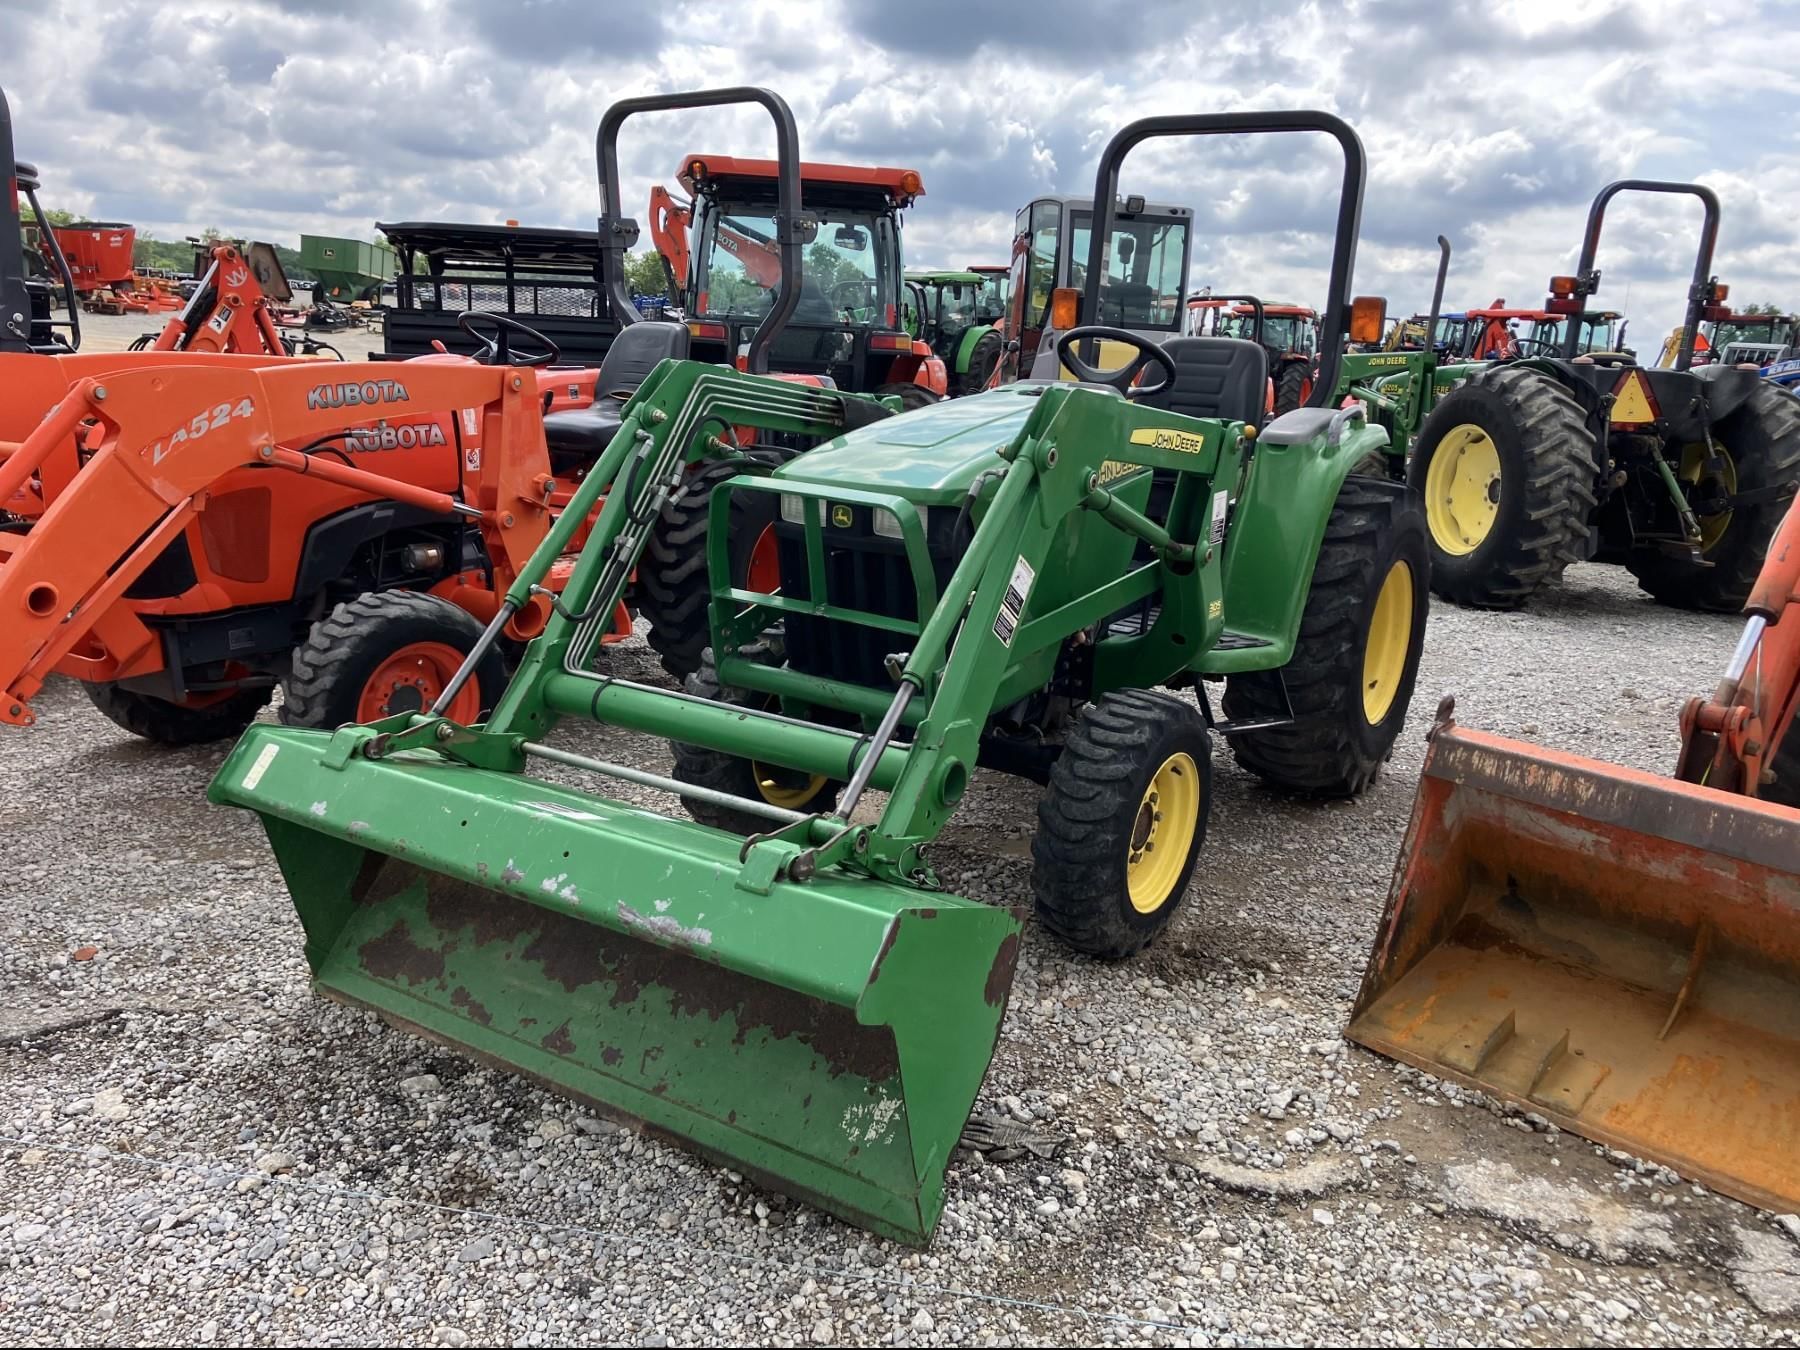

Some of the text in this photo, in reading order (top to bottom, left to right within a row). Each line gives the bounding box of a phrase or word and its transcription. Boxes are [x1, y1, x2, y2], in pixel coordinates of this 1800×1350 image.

[1368, 356, 1407, 366] JOHN DEERE
[308, 380, 410, 409] KUBOTA
[152, 398, 255, 467] LA524
[343, 423, 447, 452] KUBOTA
[1152, 430, 1200, 452] JOHN DEERE
